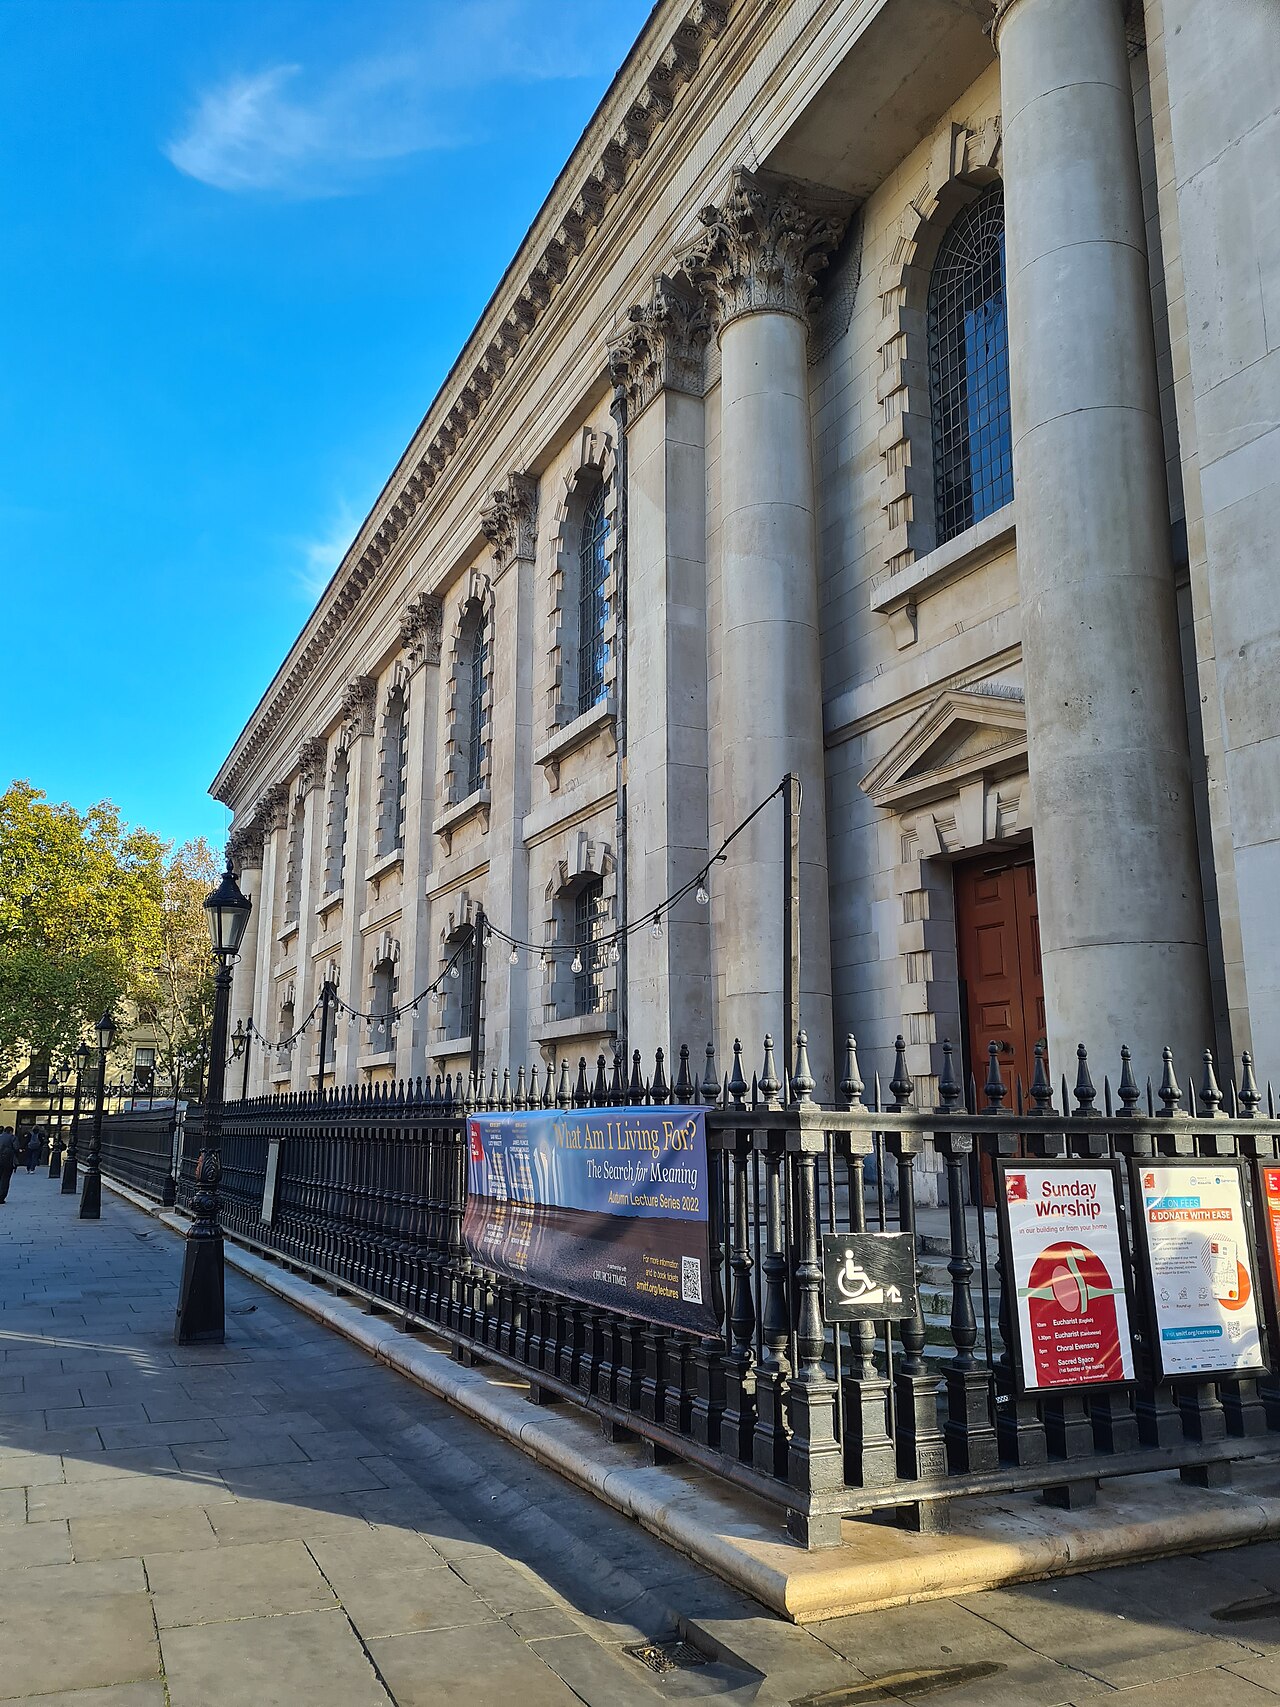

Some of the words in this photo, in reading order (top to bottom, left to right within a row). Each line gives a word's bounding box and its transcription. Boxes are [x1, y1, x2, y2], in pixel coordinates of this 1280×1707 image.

[553, 1122, 581, 1148] What
[584, 1123, 605, 1150] Am
[607, 1122, 613, 1150] I
[616, 1121, 660, 1159] Living
[662, 1120, 697, 1151] For?
[587, 1159, 601, 1178] The
[603, 1160, 634, 1181] Search
[632, 1160, 648, 1187] for
[650, 1162, 697, 1190] Meaning
[1041, 1180, 1097, 1199] Sunday
[608, 1190, 629, 1205] Autumn
[630, 1192, 658, 1208] Lecture
[659, 1193, 681, 1210] Series
[682, 1196, 700, 1212] 2022
[1167, 1199, 1179, 1207] ON
[1180, 1199, 1199, 1208] FEES
[1035, 1199, 1102, 1220] Worship
[1151, 1212, 1157, 1220] &
[1158, 1211, 1188, 1220] DONATE
[1190, 1211, 1210, 1220] WITH
[1212, 1210, 1231, 1220] EASE
[1036, 1226, 1058, 1234] building
[592, 1270, 612, 1283] CHURCH
[612, 1272, 628, 1287] TIMES
[1053, 1317, 1078, 1326] Eucharist
[1056, 1343, 1075, 1352] Choral
[1075, 1342, 1100, 1351] Evensong
[1057, 1357, 1078, 1366] Sacred
[1078, 1356, 1095, 1366] Space
